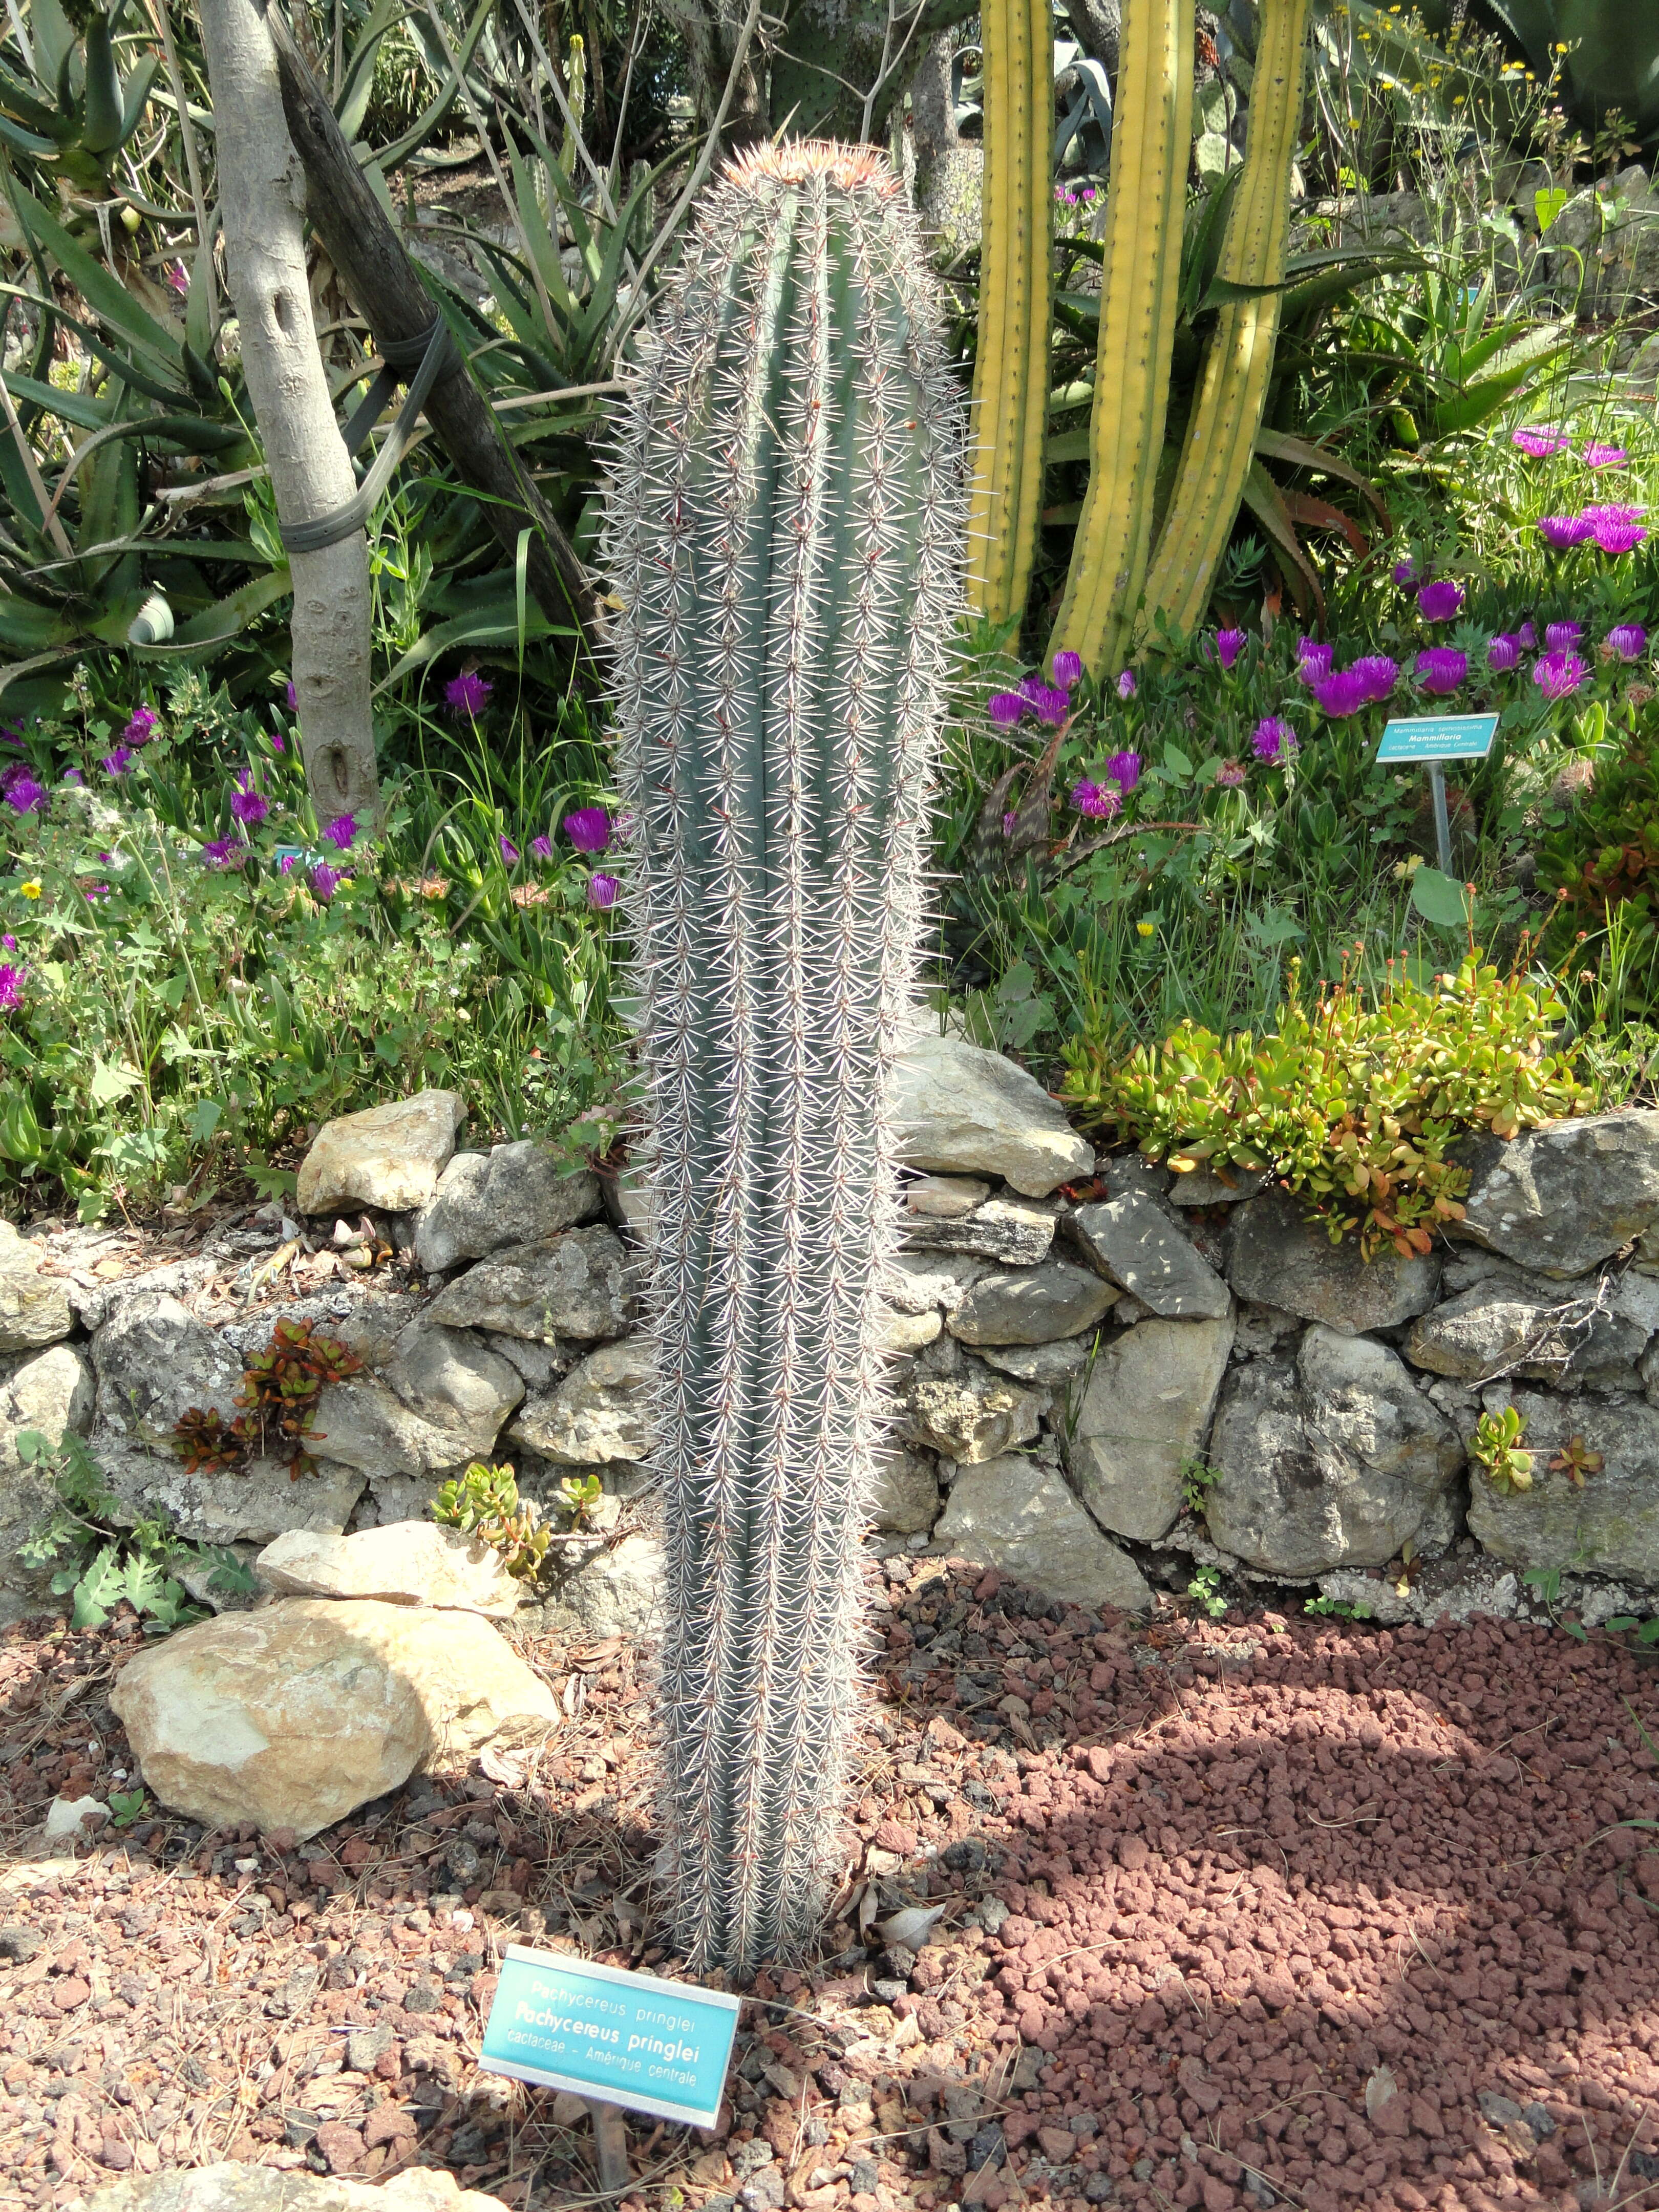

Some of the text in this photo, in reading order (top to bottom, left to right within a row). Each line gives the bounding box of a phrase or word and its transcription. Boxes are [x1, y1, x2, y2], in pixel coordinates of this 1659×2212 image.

[1409, 734, 1461, 742] Mammillaria
[516, 2001, 699, 2062] Pachycereus pringlei
[531, 1980, 695, 2032] Pachycereus pringlei
[507, 2029, 565, 2053] cactaceae
[585, 2047, 642, 2072] Amérique
[648, 2062, 696, 2087] centrale
